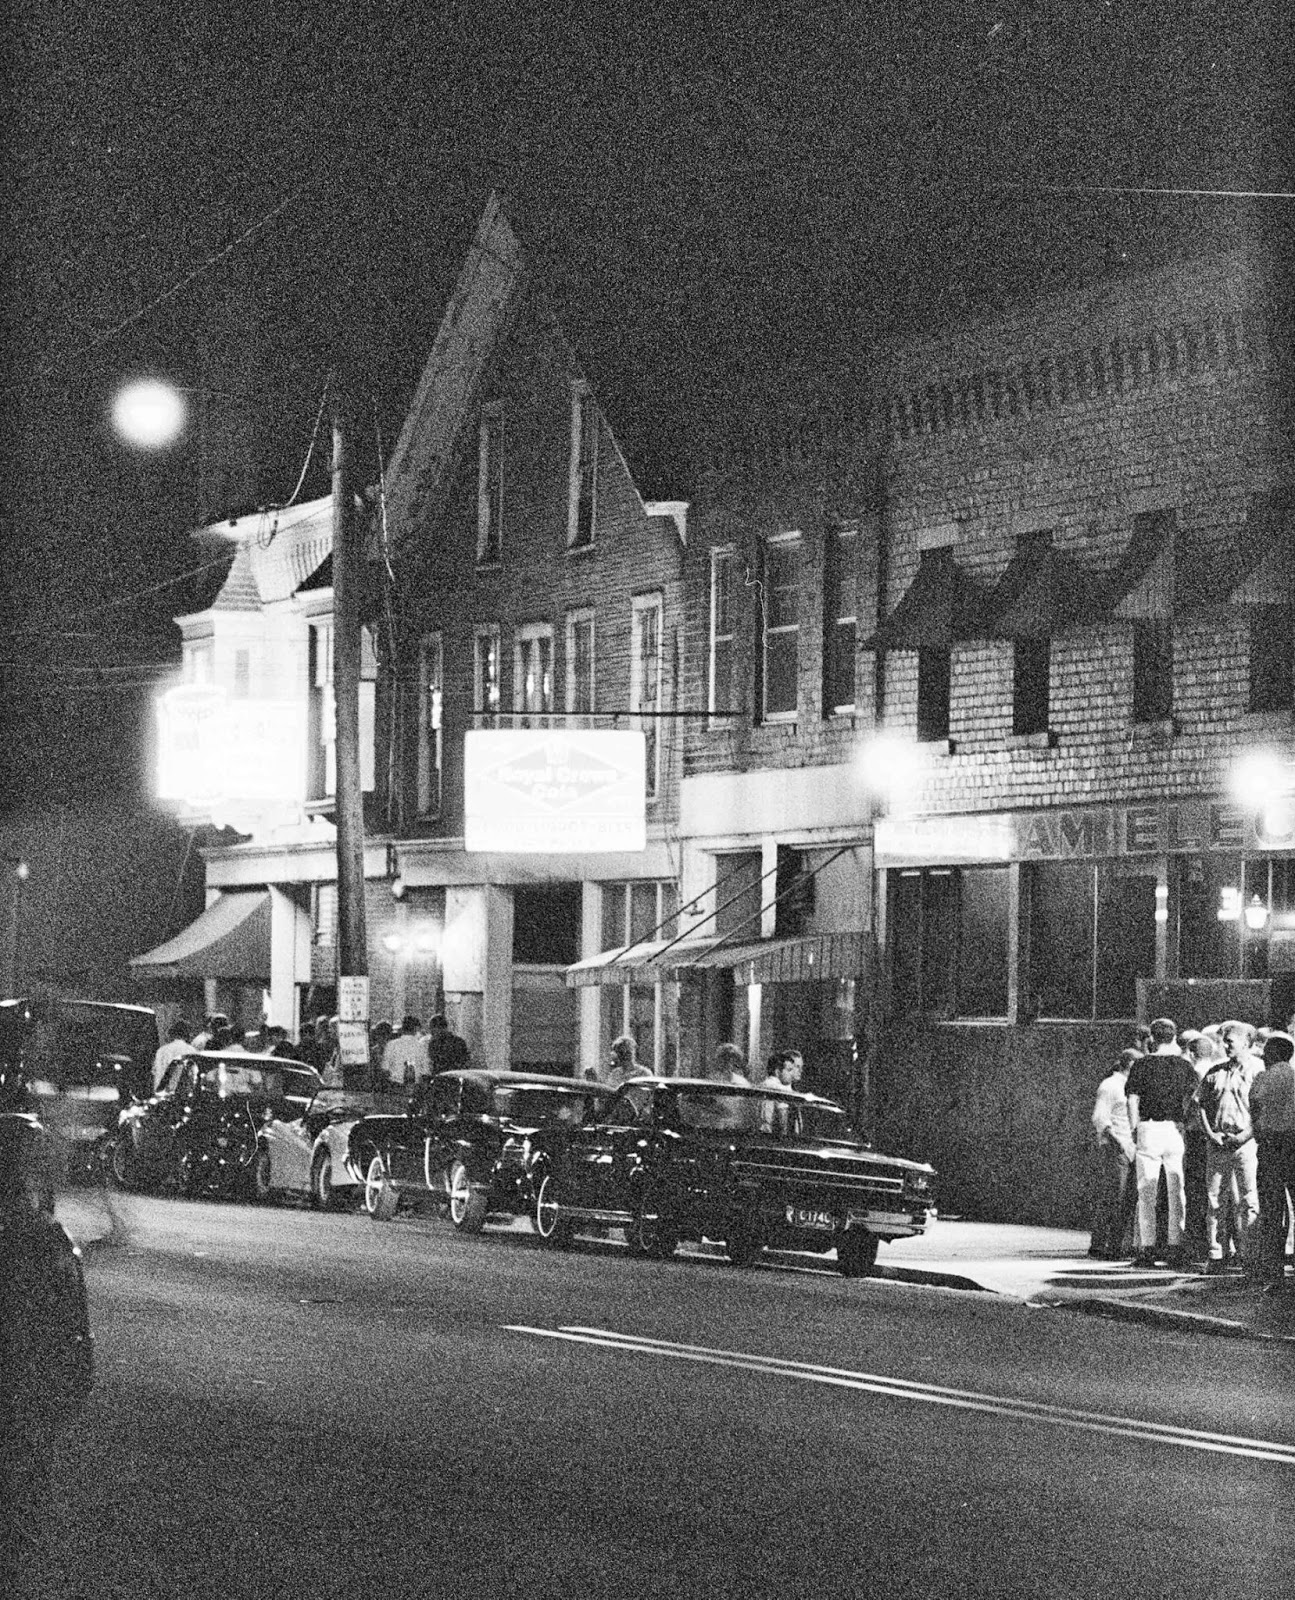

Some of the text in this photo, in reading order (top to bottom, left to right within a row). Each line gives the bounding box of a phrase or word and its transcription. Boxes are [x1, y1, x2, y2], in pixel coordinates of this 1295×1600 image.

[497, 766, 617, 785] Royal Crown
[531, 784, 578, 800] Cola
